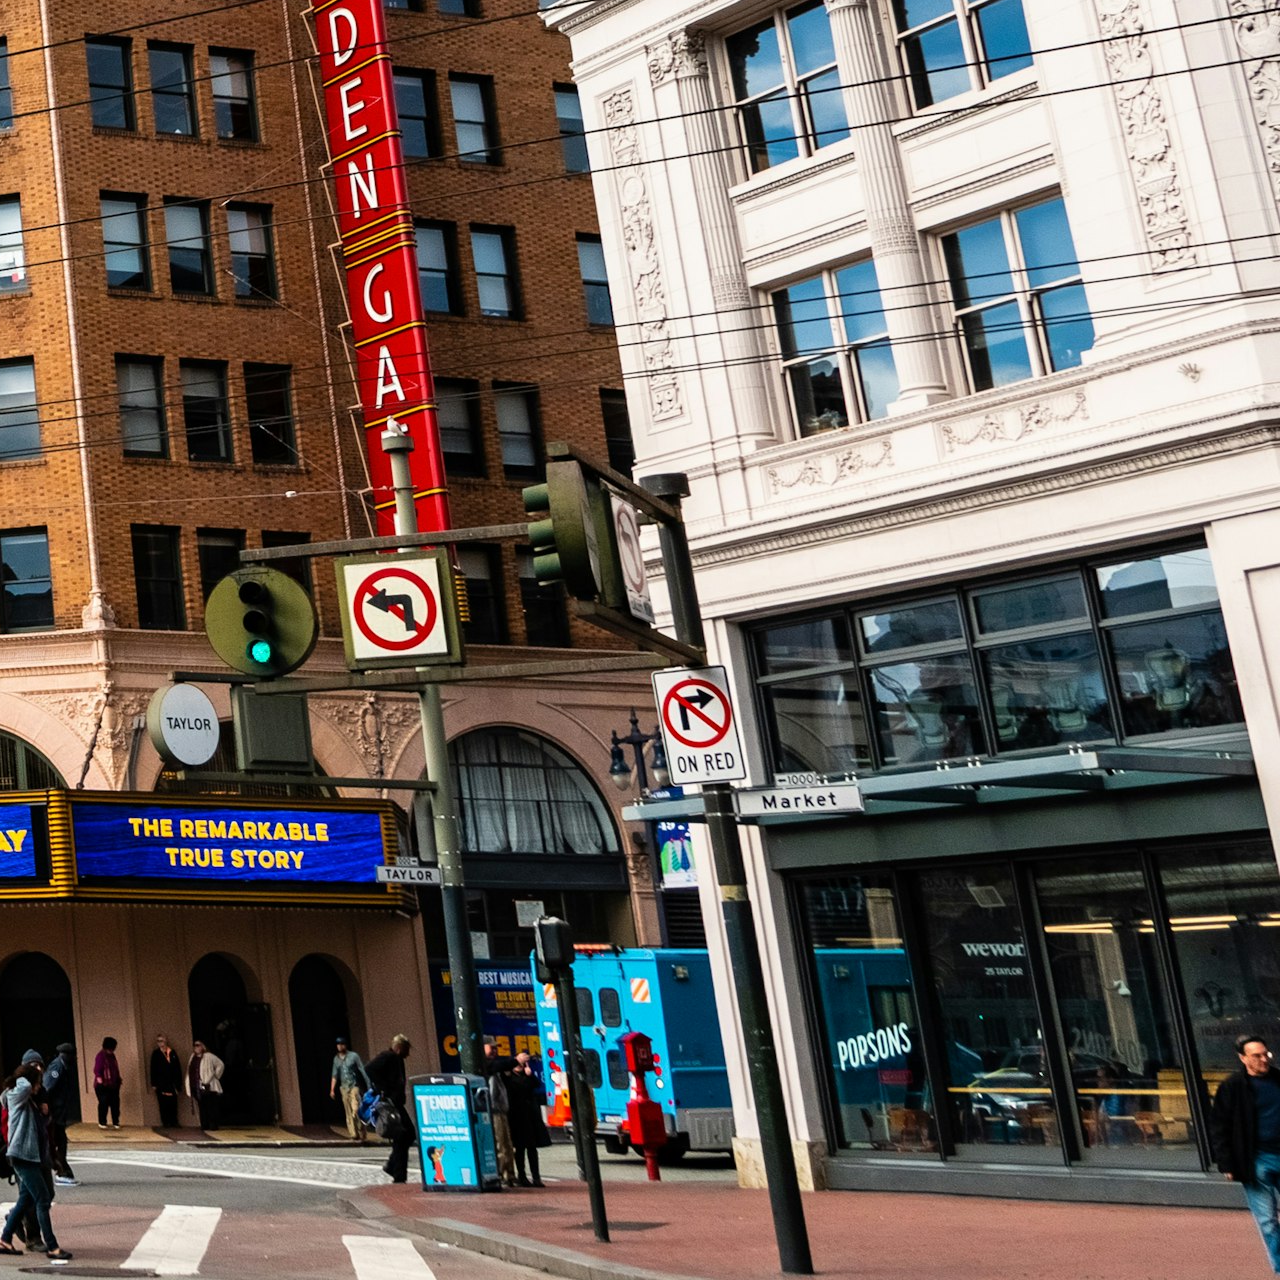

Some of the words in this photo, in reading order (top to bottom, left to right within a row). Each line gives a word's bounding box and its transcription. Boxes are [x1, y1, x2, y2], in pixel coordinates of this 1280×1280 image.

[166, 717, 211, 731] TAYLOR
[677, 756, 698, 773] ON
[704, 752, 735, 770] RED
[787, 773, 814, 785] 1000
[762, 793, 837, 810] Market
[128, 817, 174, 838] THE
[179, 819, 329, 842] REMARKABLE
[165, 847, 225, 867] TRUE
[230, 849, 304, 869] STORY
[385, 868, 433, 881] TAYLOR
[478, 971, 499, 985] BEST
[984, 967, 994, 975] 25
[995, 967, 1023, 976] TAYLOR
[494, 992, 507, 1001] THIS
[508, 992, 527, 1001] STORY
[443, 1035, 511, 1056] CE
[837, 1022, 912, 1071] POPSONS
[416, 1094, 465, 1125] TENDER
